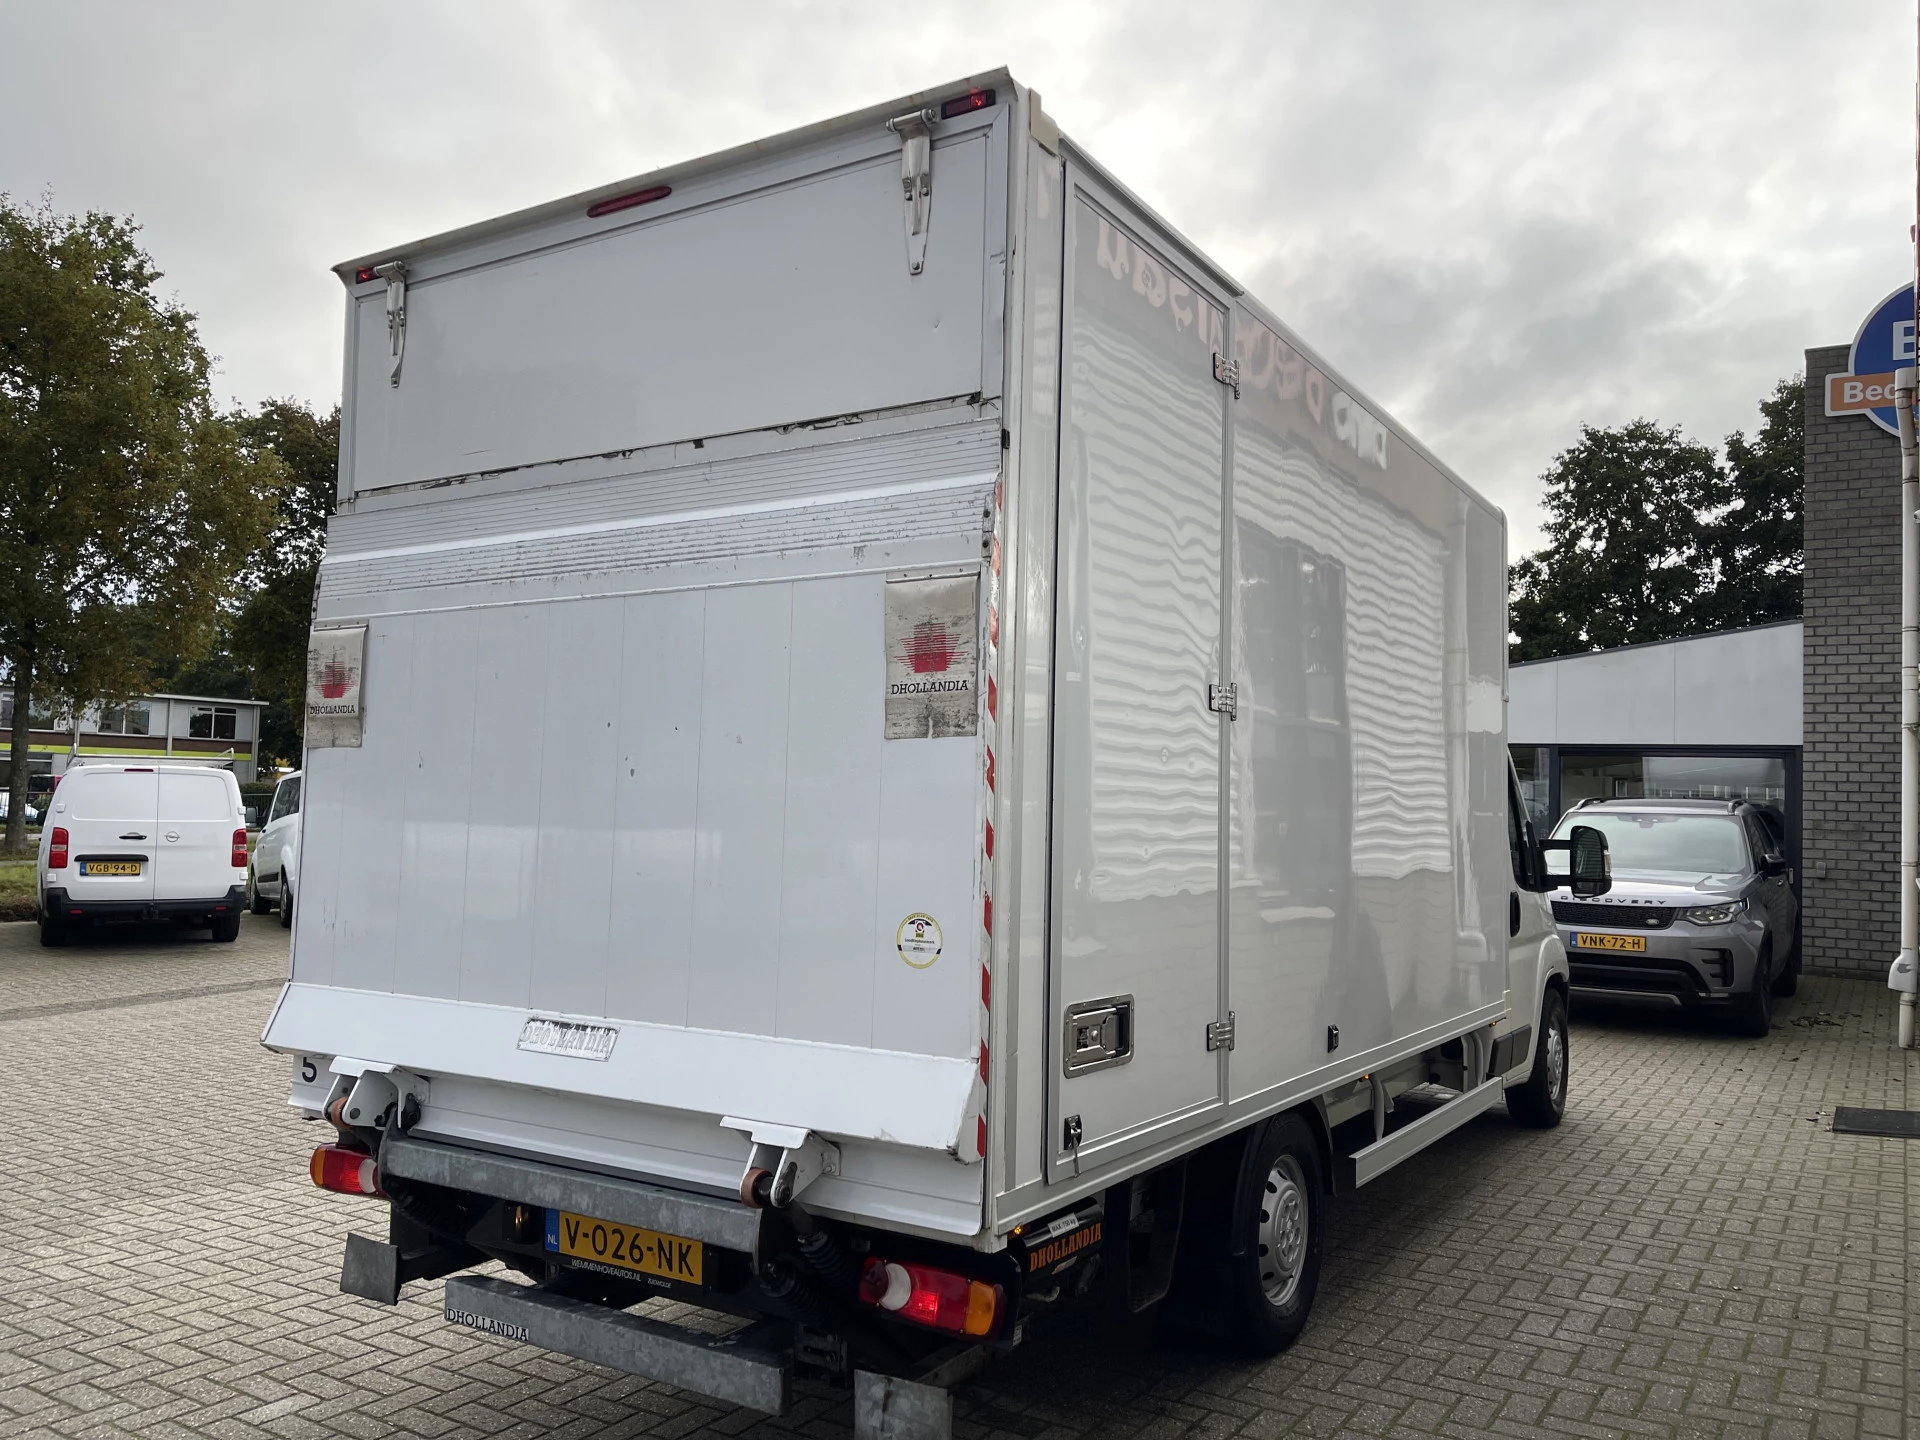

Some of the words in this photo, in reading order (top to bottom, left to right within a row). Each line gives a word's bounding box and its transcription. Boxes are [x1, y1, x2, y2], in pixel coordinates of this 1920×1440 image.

[891, 680, 969, 695] DHOLLANDIA
[310, 705, 355, 714] DHOLLANDIA
[88, 864, 138, 873] VGB-94-D
[1560, 895, 1667, 905] DISCOVERY
[1581, 935, 1641, 950] VNK-72-H
[547, 1233, 558, 1246] NL
[565, 1217, 695, 1277] V-026-NK
[1030, 1222, 1102, 1273] DHOLLANDIA
[571, 1258, 642, 1282] WEMMENHOVEAUTOS.NL
[447, 1308, 529, 1342] DHOLLANDIA
